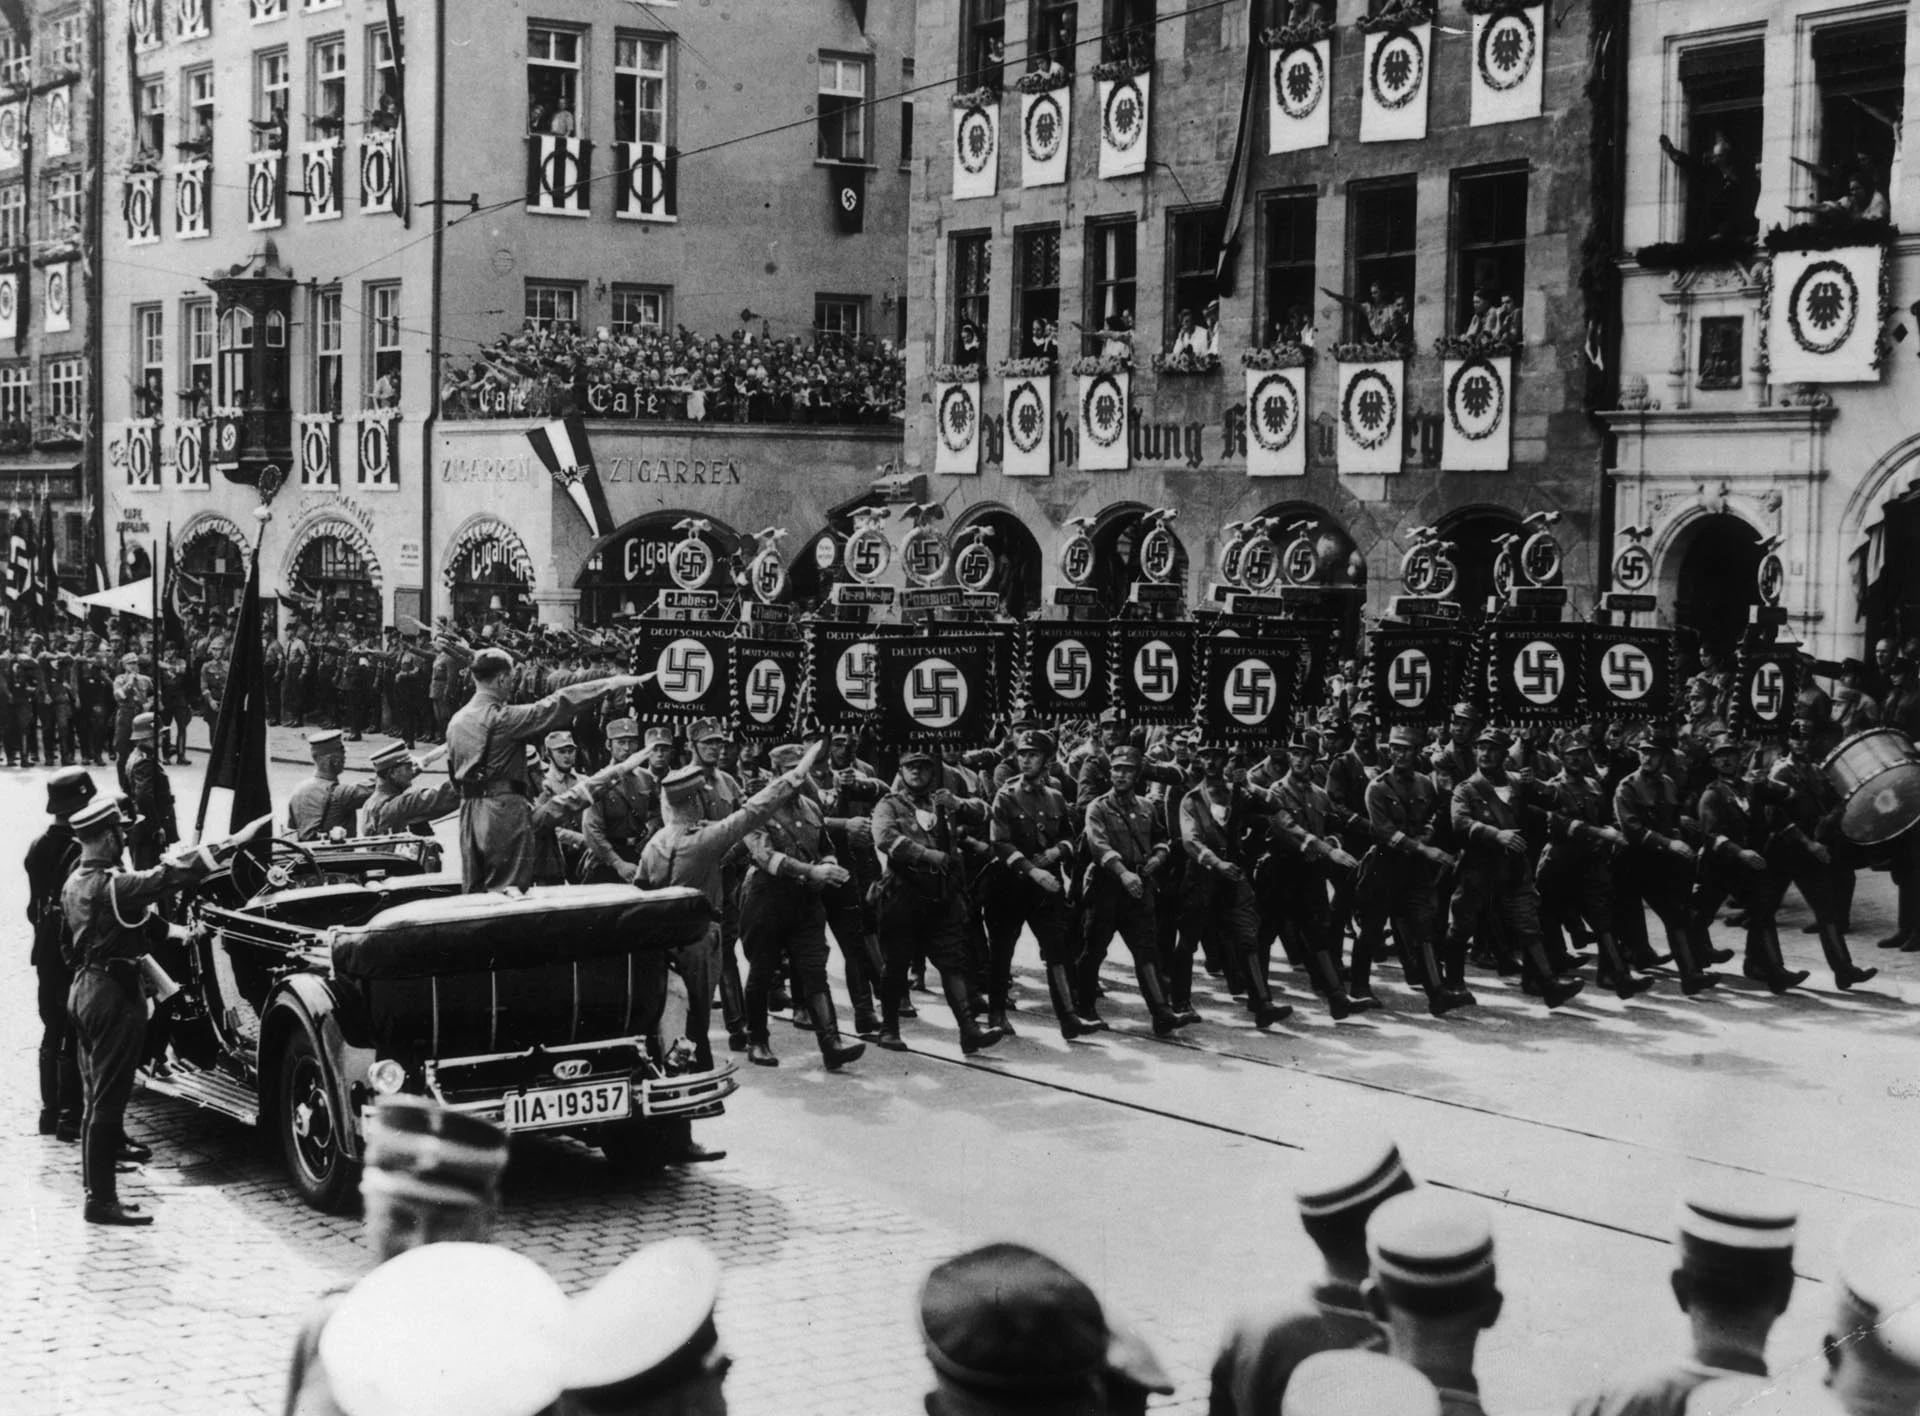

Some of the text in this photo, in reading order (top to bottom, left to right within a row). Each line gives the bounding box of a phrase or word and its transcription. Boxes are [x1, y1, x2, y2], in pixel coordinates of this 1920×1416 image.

[587, 383, 659, 418] Cafe
[610, 456, 744, 485] ZIGARREN
[651, 628, 726, 638] DEUTSCHLAND
[742, 648, 795, 658] DEUTSCHLAND
[892, 646, 977, 657] DEUTSCHLAND
[657, 702, 705, 711] ERWACHE
[910, 730, 961, 740] ERWACHE
